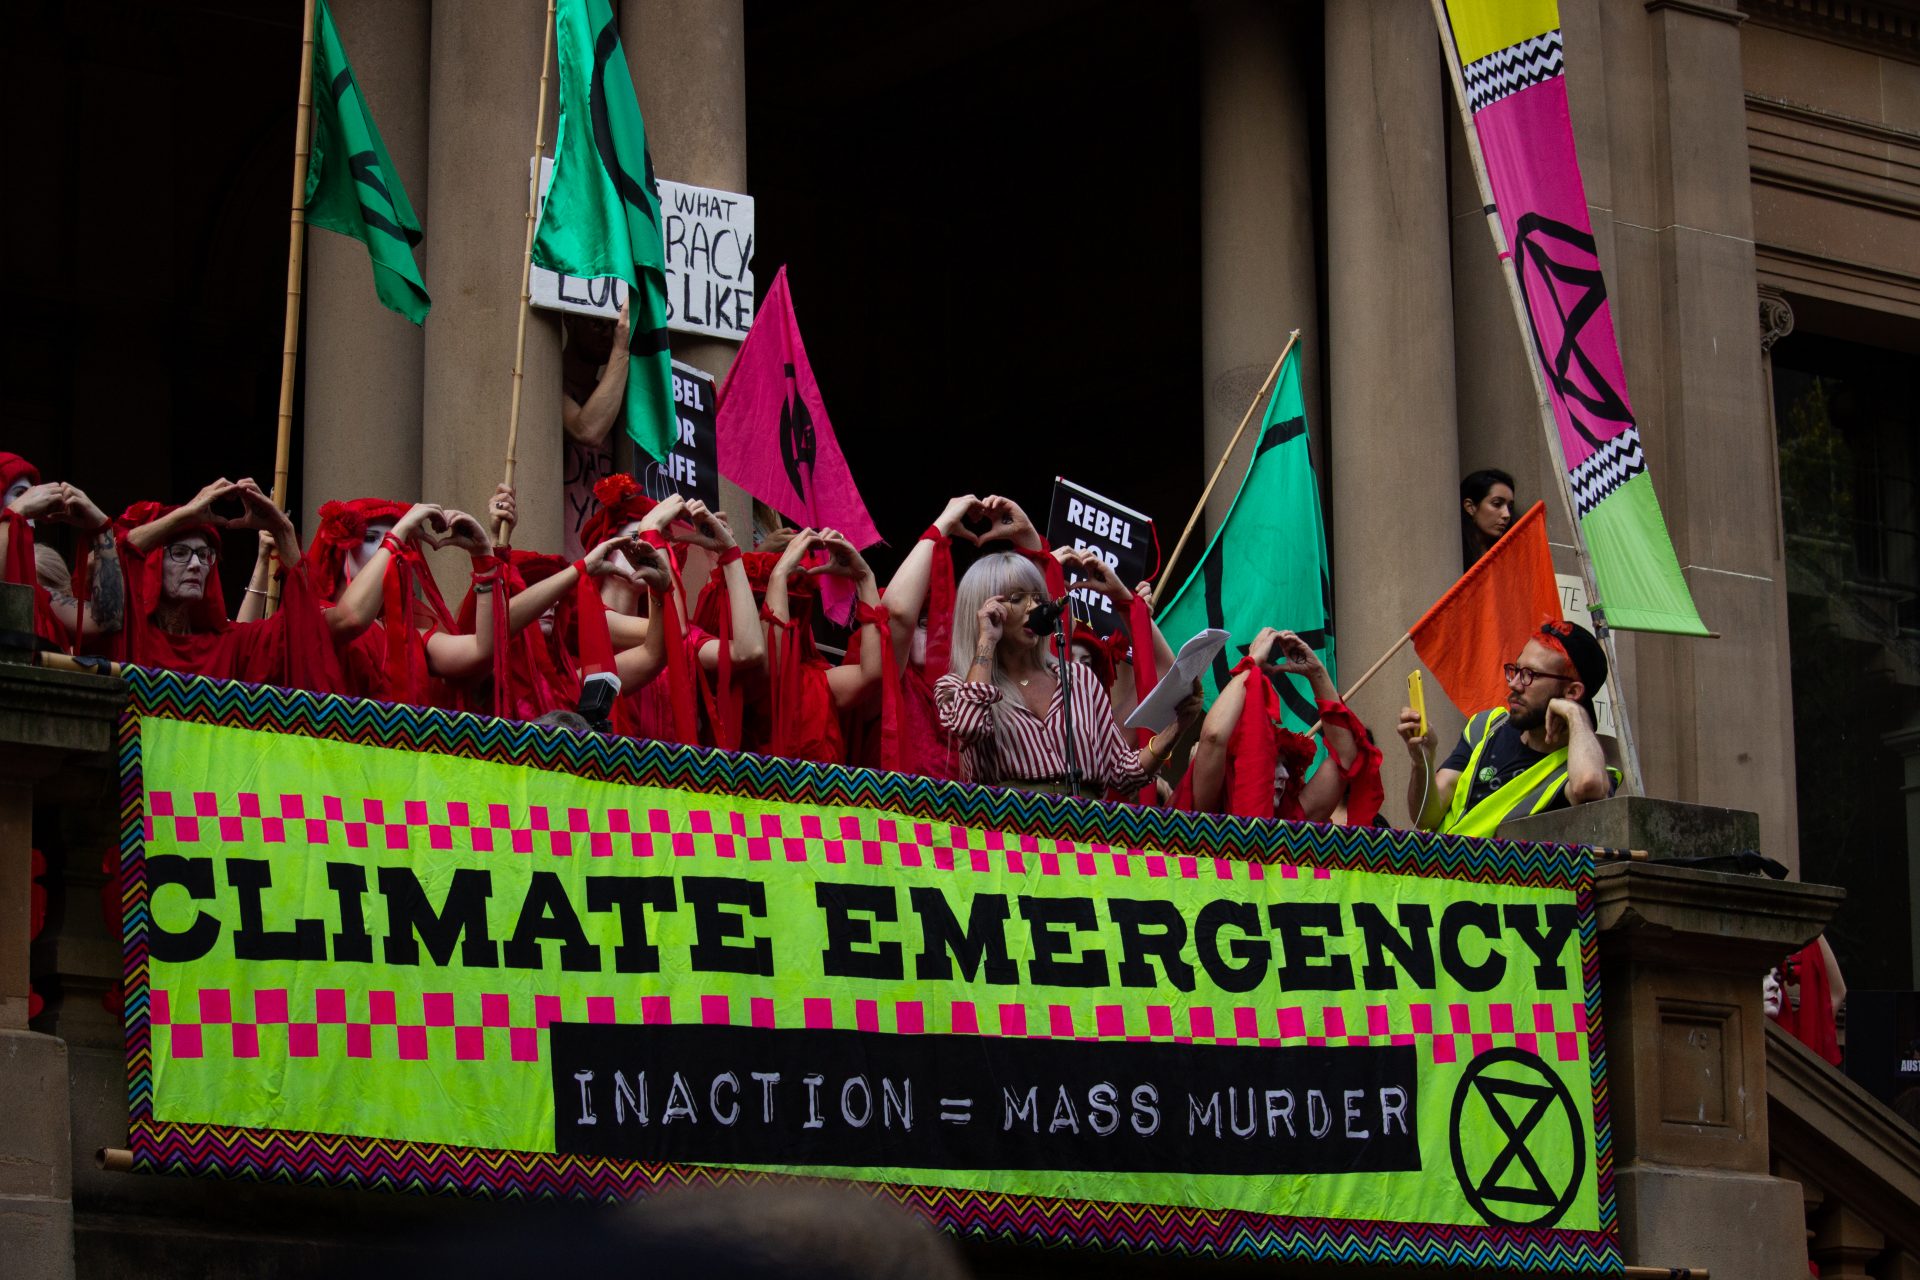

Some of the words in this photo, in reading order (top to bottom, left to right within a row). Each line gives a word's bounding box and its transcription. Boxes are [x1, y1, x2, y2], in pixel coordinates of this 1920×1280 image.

[675, 189, 737, 222] WHAT
[664, 215, 752, 283] RACY
[683, 272, 753, 332] LIKE
[671, 374, 704, 412] BEL
[1067, 497, 1133, 549] REBEL
[146, 853, 775, 977] CLIMATE
[814, 880, 1579, 993] EMERGENCY
[573, 1069, 914, 1132] INACTION
[1002, 1081, 1160, 1138] MASS
[1188, 1084, 1409, 1140] MURDER
